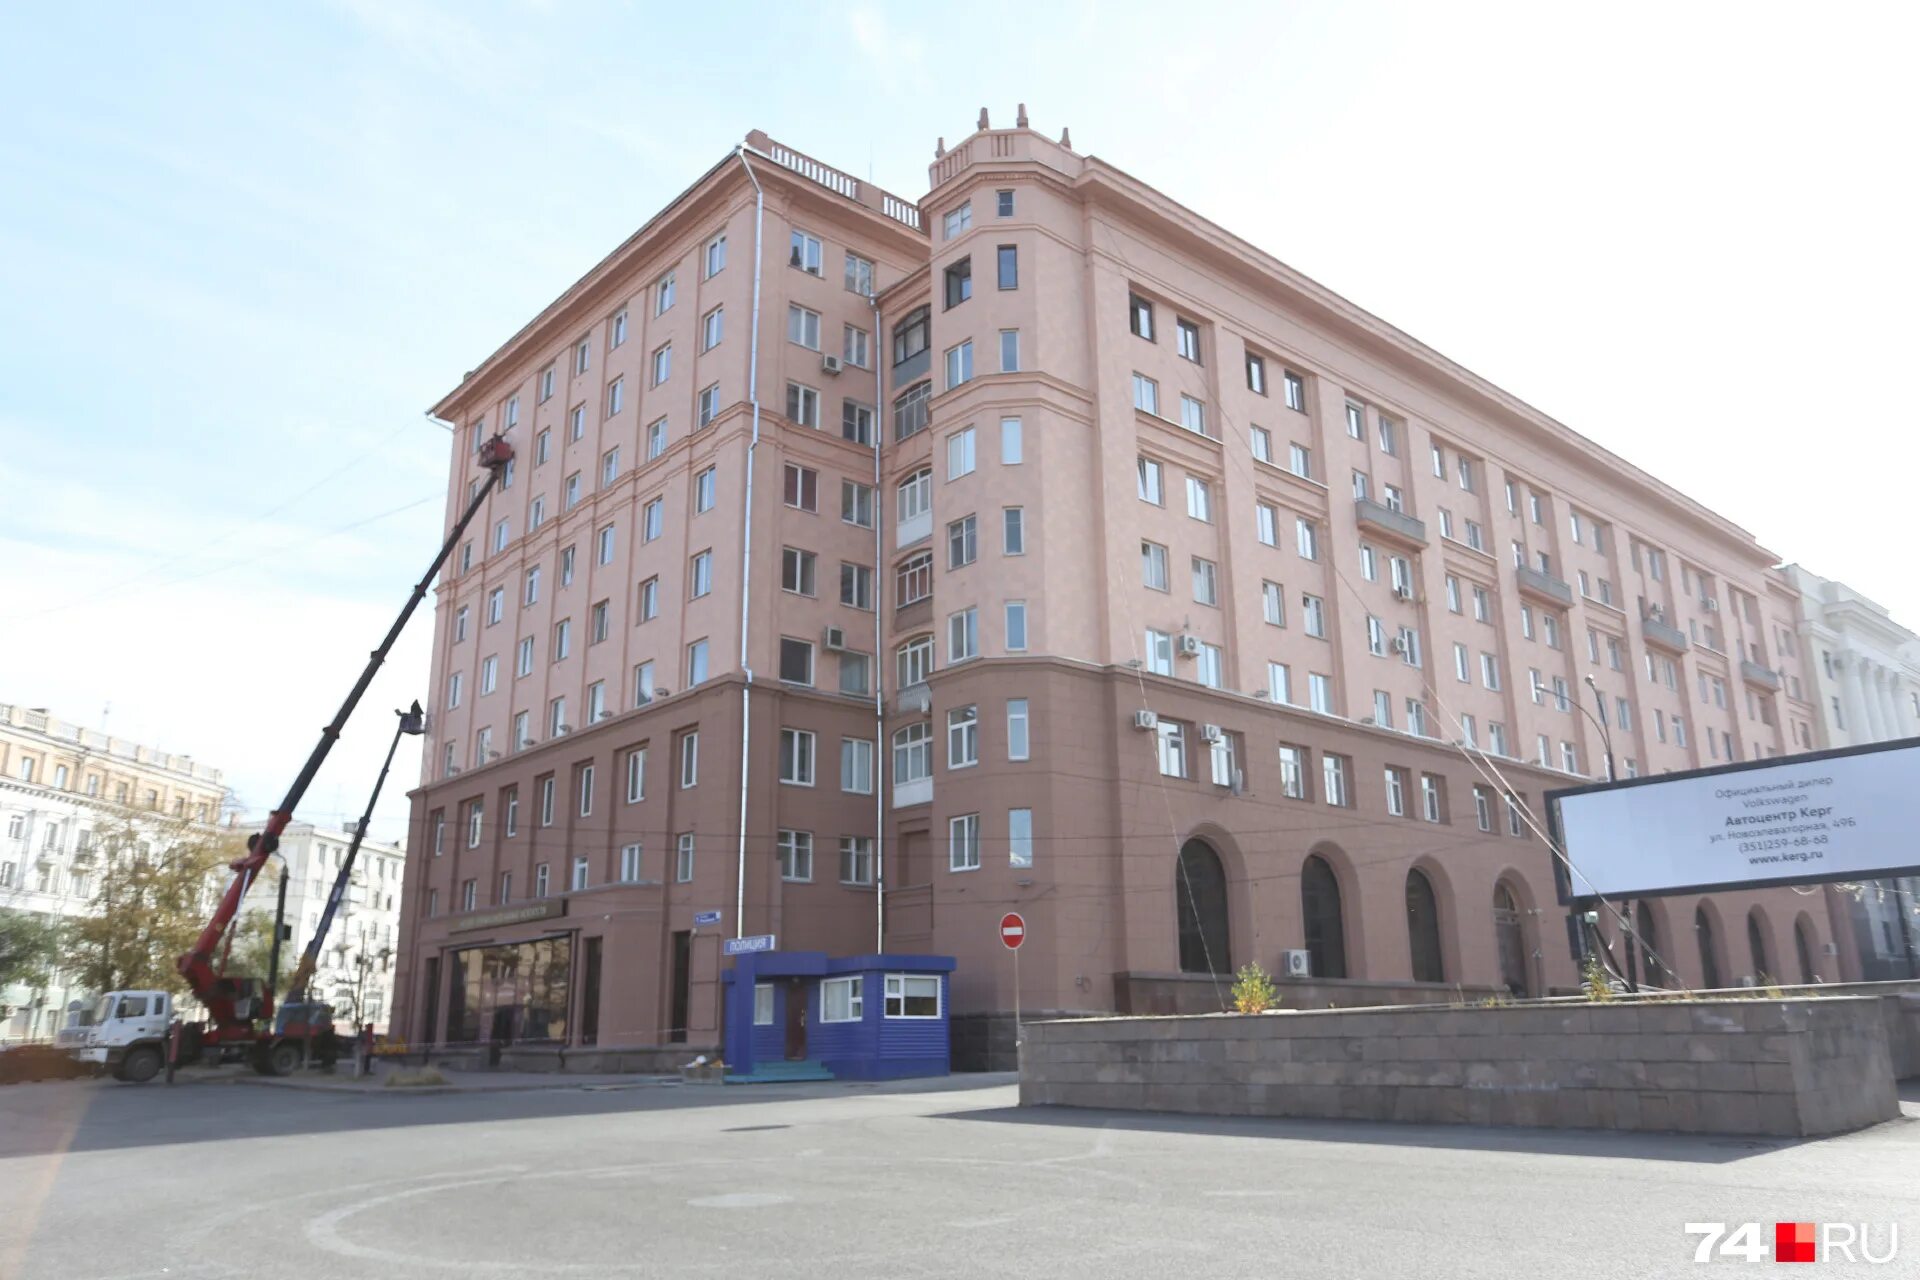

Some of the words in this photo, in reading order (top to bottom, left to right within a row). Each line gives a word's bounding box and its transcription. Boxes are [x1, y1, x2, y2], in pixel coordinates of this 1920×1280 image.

[1715, 780, 1795, 799] Официальный
[1798, 776, 1833, 789] дилер
[1743, 794, 1808, 808] Volkswagen
[1725, 810, 1797, 826] Автоцентр
[1800, 806, 1833, 819] Керг
[1709, 834, 1725, 843] ул.
[1749, 851, 1823, 865] www.kerg.ru
[729, 937, 767, 953] ПОЛИЦИЯ
